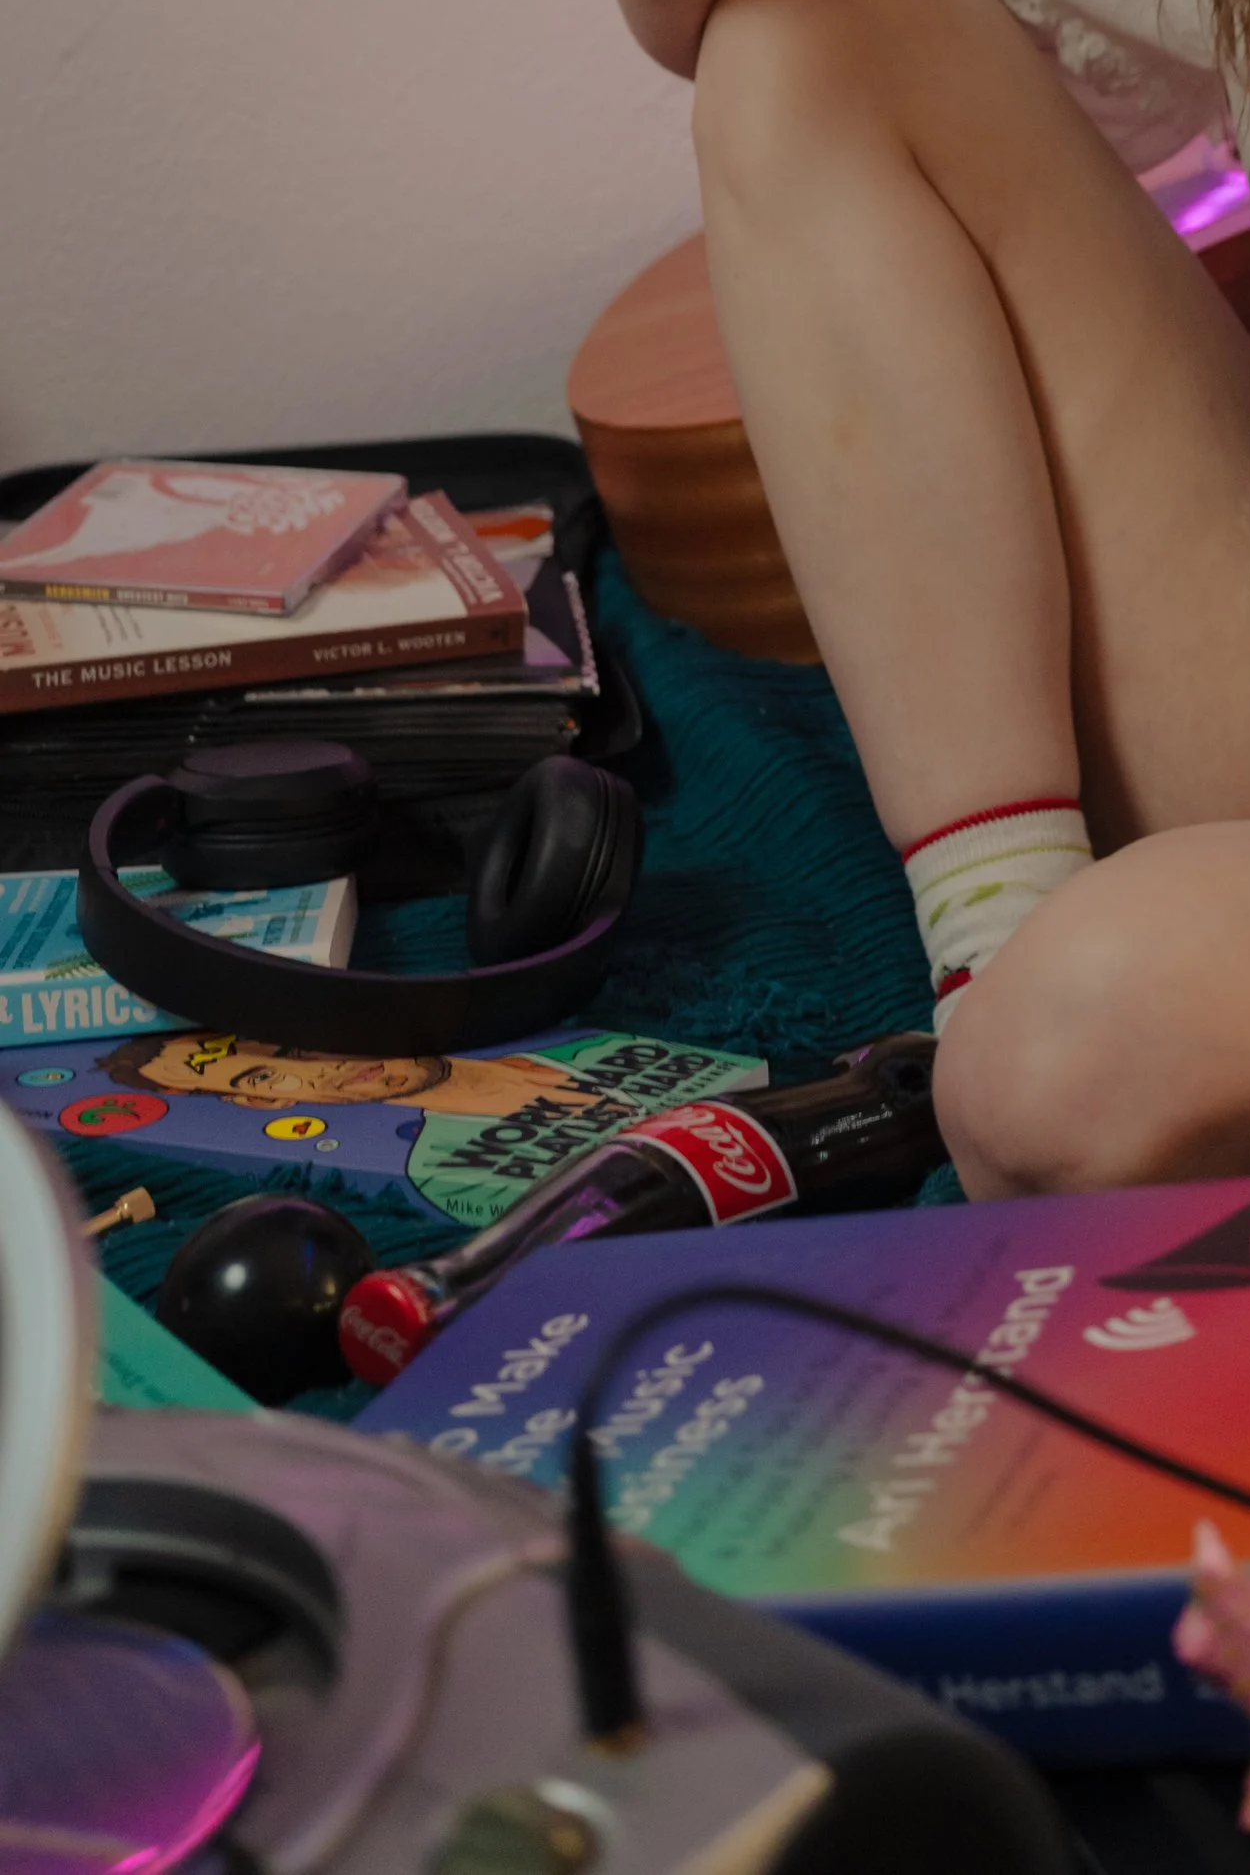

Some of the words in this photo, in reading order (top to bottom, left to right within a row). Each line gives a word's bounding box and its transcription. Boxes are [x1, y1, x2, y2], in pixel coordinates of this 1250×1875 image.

[31, 666, 75, 691] THE
[79, 658, 148, 685] MUSIC
[153, 648, 234, 676] LESSON
[312, 641, 373, 664] VICTOR
[376, 638, 394, 657] L.
[397, 629, 467, 653] WOOTEN
[436, 1094, 586, 1167] WORK
[555, 1044, 670, 1098] HARD
[625, 1052, 716, 1100] HARD
[446, 1197, 484, 1216] Mike
[449, 1312, 591, 1418] Make
[587, 1340, 715, 1461] Music
[832, 1477, 940, 1554] Ari
